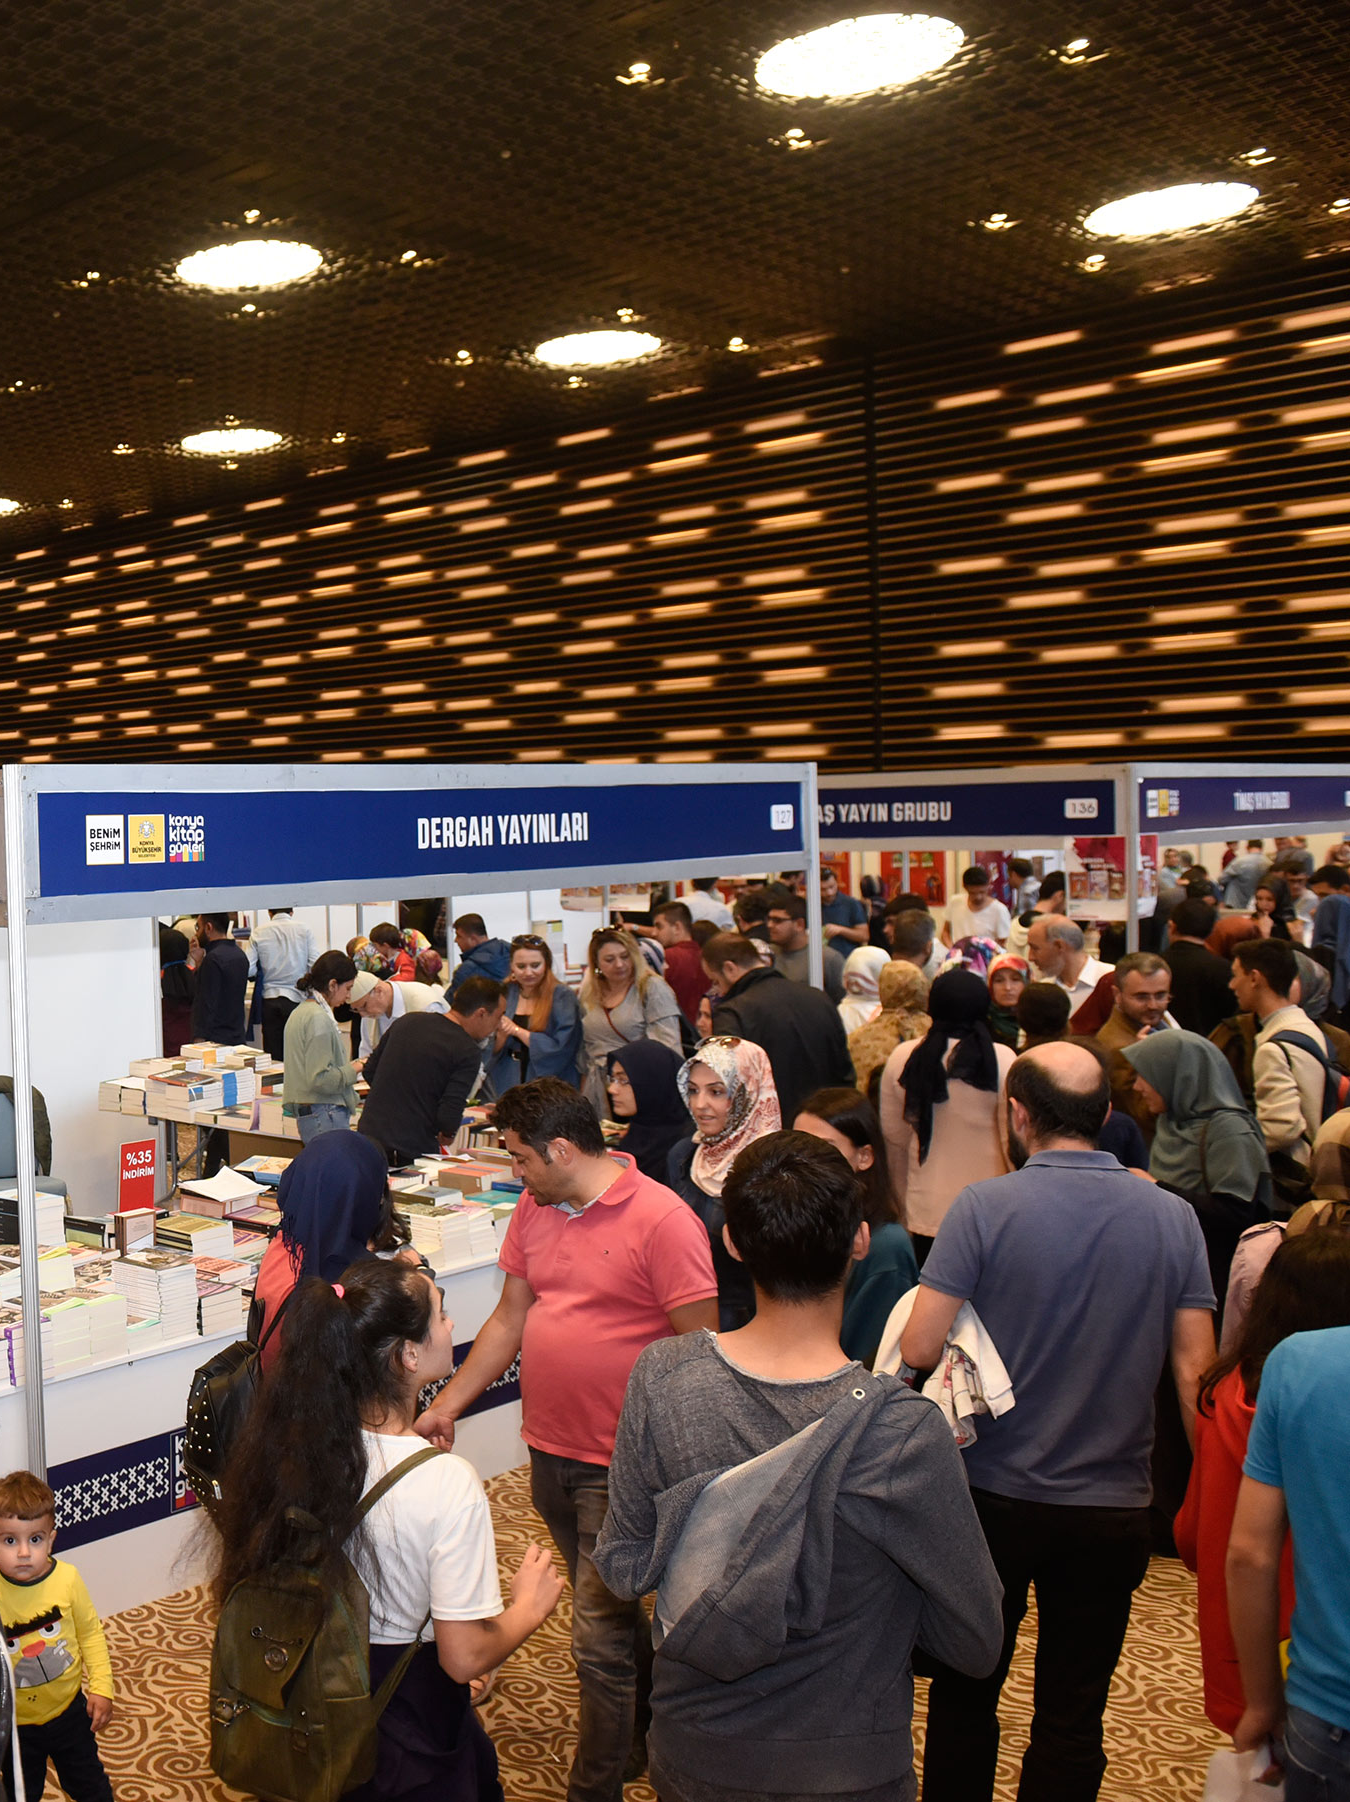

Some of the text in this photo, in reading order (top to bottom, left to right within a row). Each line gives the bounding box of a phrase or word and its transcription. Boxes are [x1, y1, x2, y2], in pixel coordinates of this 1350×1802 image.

[837, 803, 888, 823] YAYIN
[892, 801, 951, 822] GRUBU
[1071, 802, 1095, 814] 136
[168, 814, 204, 829] konya
[776, 810, 791, 824] 127
[169, 827, 204, 843] kitap
[417, 812, 589, 850] DERGAH YAYINLARI
[169, 842, 204, 857] günleri
[126, 1150, 152, 1167] %35
[122, 1166, 154, 1180] İNDİRİM
